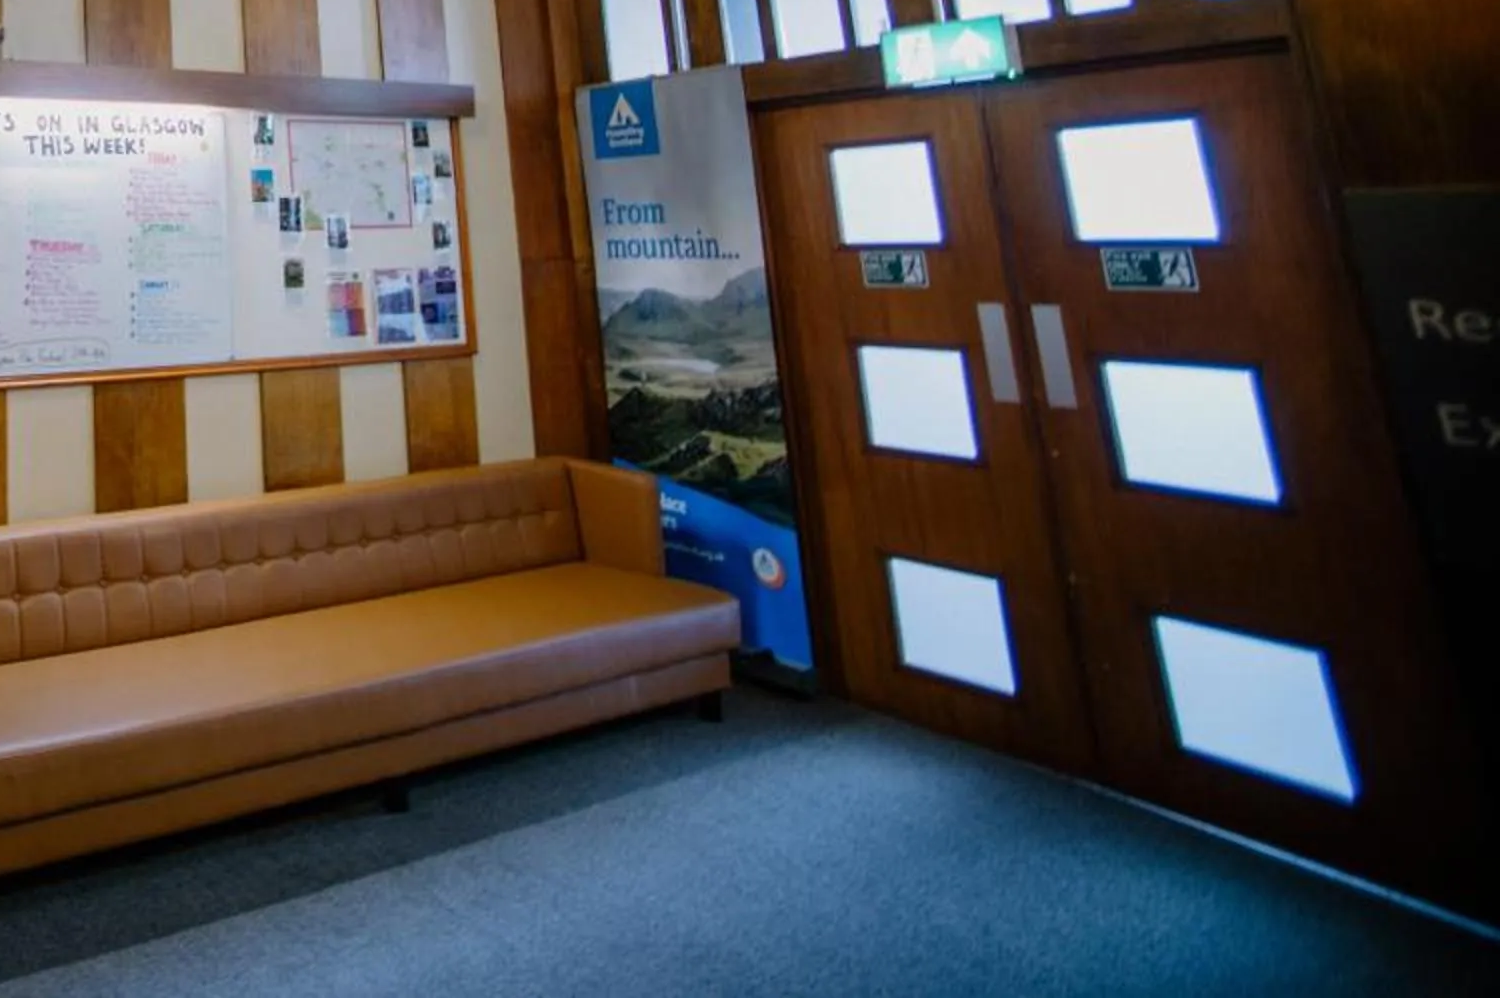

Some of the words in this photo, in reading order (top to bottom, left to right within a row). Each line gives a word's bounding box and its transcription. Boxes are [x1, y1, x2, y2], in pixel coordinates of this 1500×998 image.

[36, 114, 62, 132] ON
[77, 114, 101, 133] IN
[110, 114, 205, 137] GLASGOW
[22, 135, 75, 156] THIS
[83, 138, 146, 155] WEEK!
[602, 198, 666, 225] From
[606, 227, 741, 260] mountain...
[1408, 297, 1500, 343] Re
